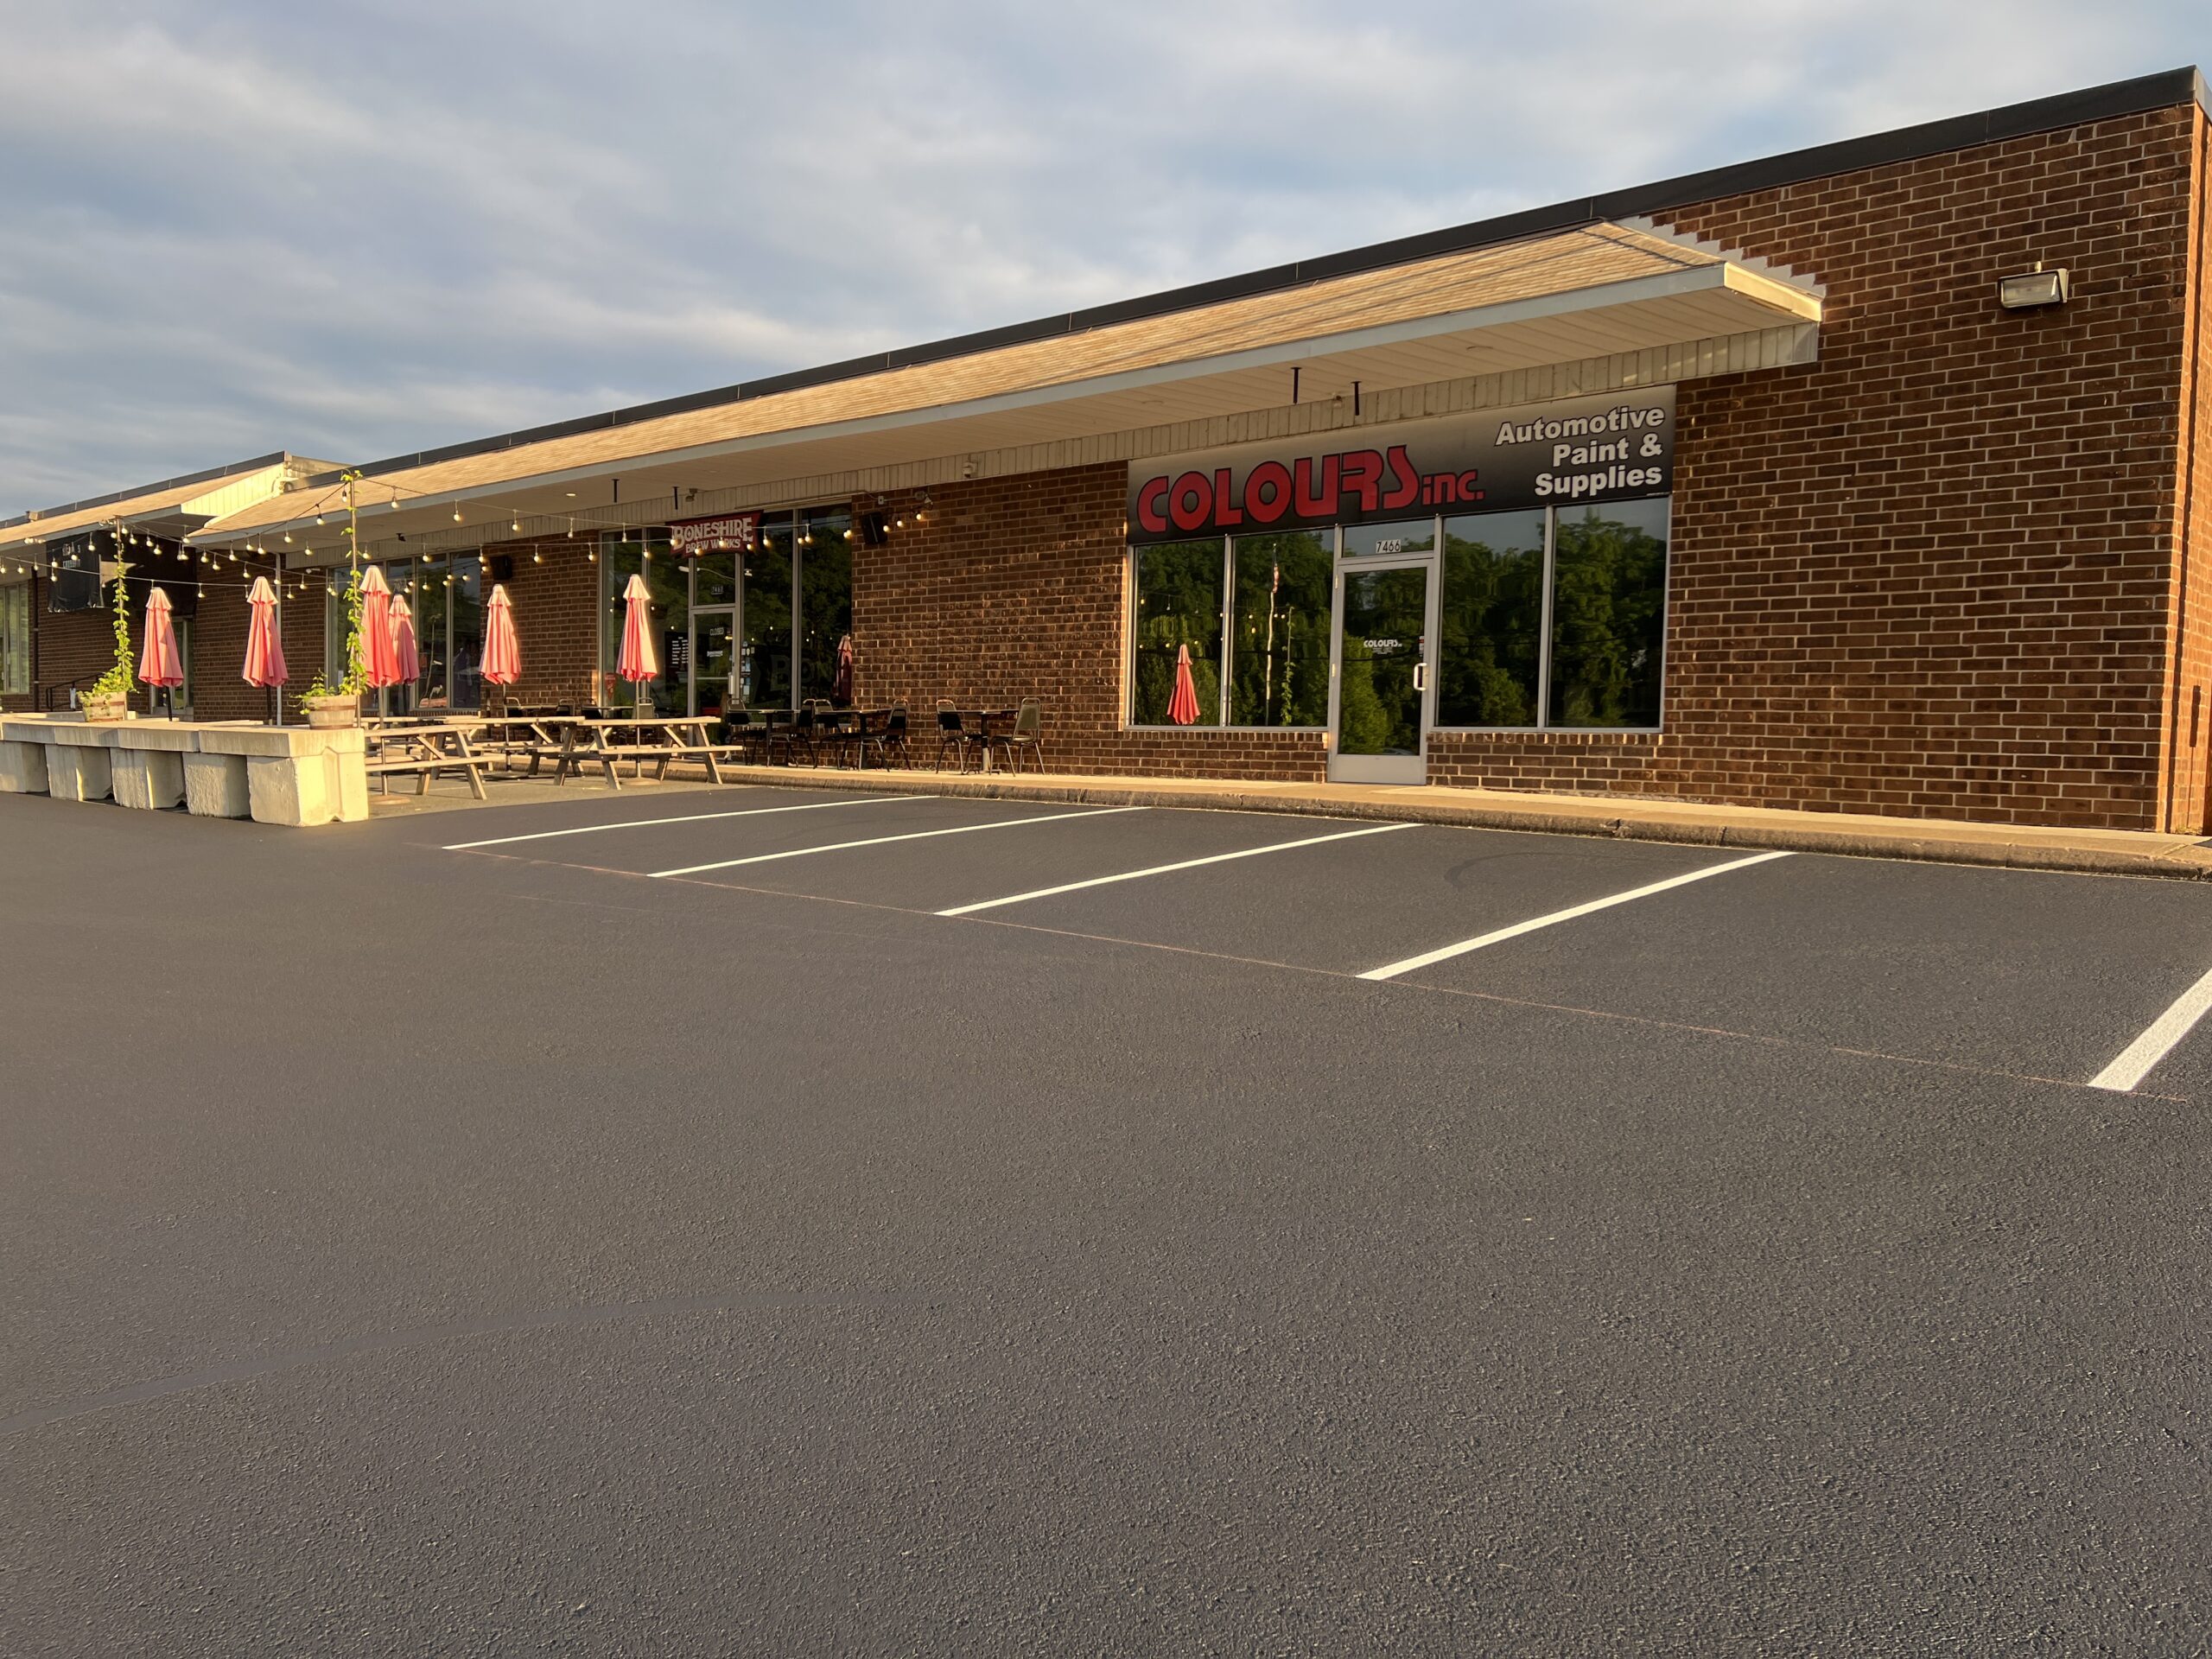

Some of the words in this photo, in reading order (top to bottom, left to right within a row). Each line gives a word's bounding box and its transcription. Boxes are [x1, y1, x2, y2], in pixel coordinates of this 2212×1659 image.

[1494, 405, 1665, 446] Automotive
[1552, 435, 1630, 468] Paint
[1639, 430, 1663, 456] &
[1136, 445, 1419, 532] COLOURS
[1421, 468, 1486, 505] inc.
[1534, 462, 1662, 499] Supplies
[672, 517, 754, 550] BONESHIRE
[1376, 541, 1401, 552] 7466
[1363, 639, 1398, 648] COLOURS
